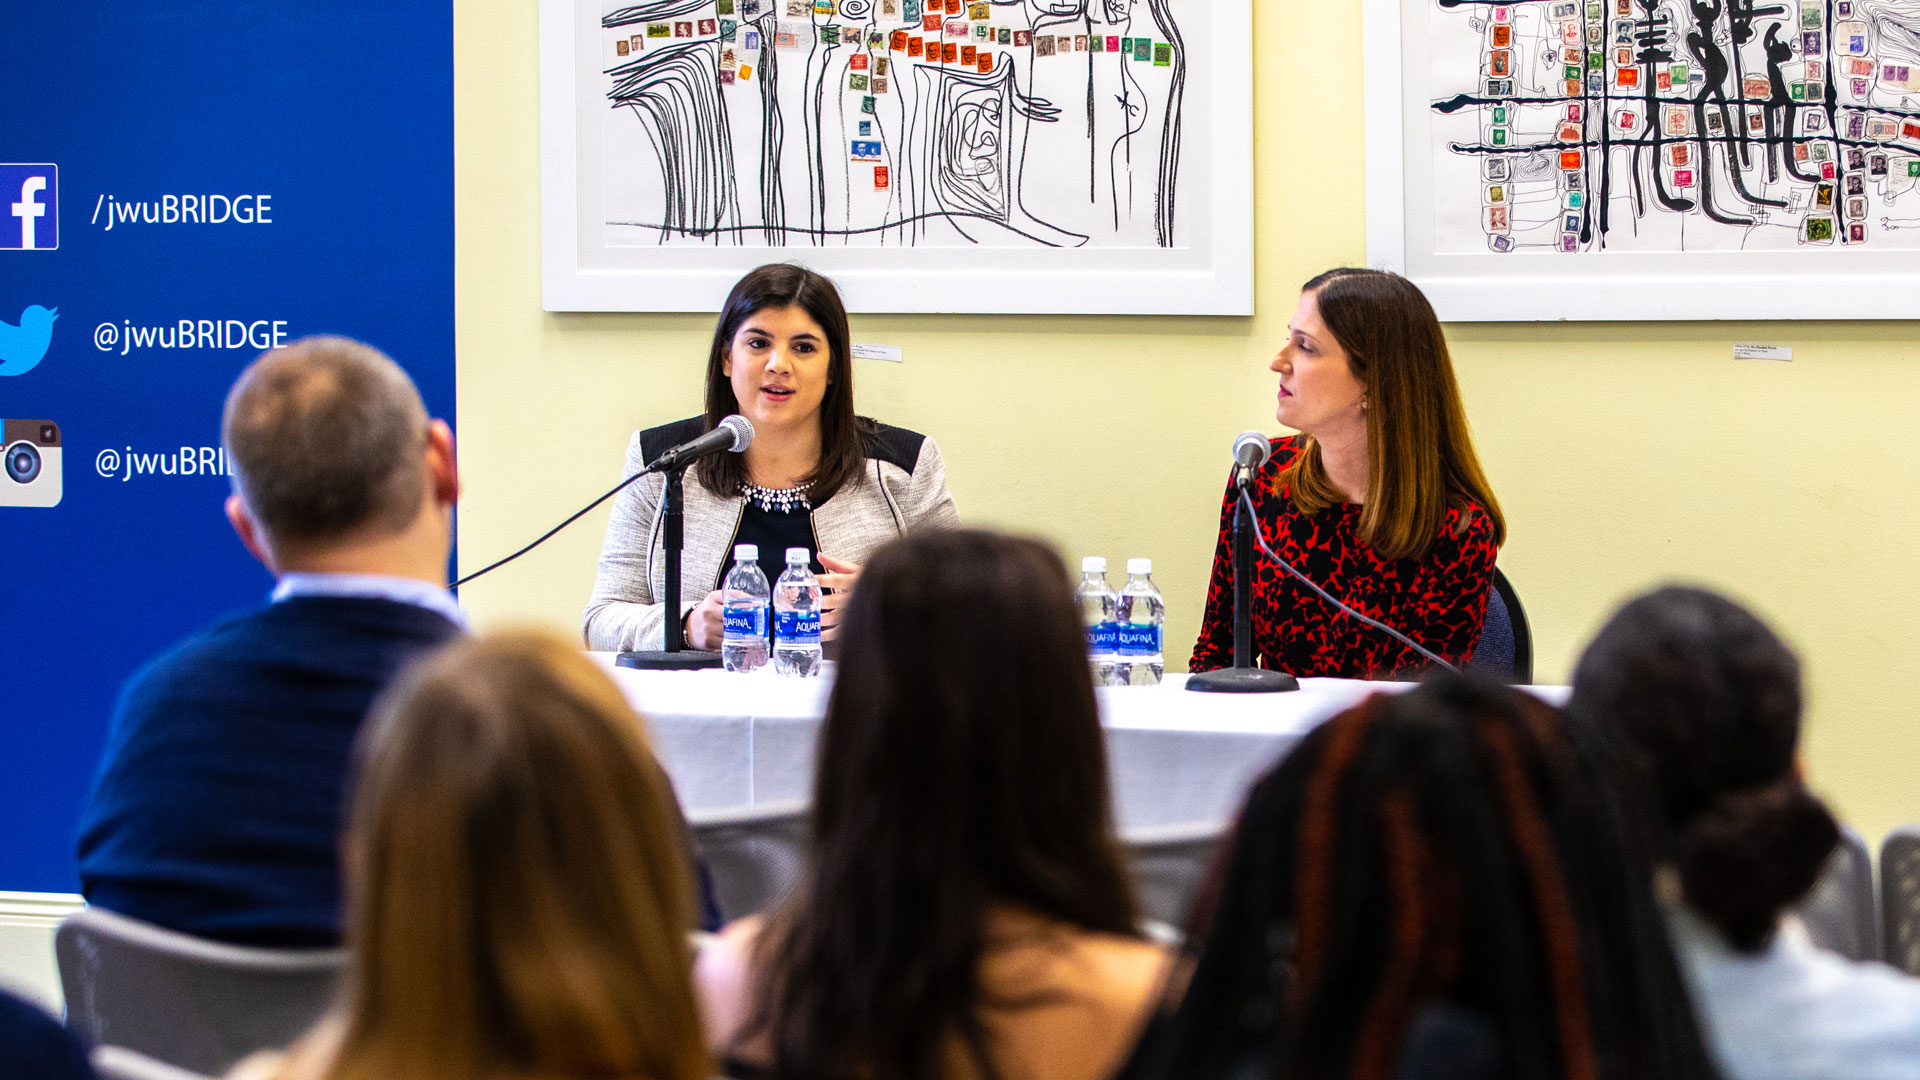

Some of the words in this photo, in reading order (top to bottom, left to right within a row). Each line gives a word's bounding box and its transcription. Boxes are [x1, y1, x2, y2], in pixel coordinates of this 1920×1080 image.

[91, 194, 273, 232] /jwuBRIDGE
[94, 319, 289, 356] @jwuBRIDGE
[1118, 632, 1155, 645] AQUAFINA
